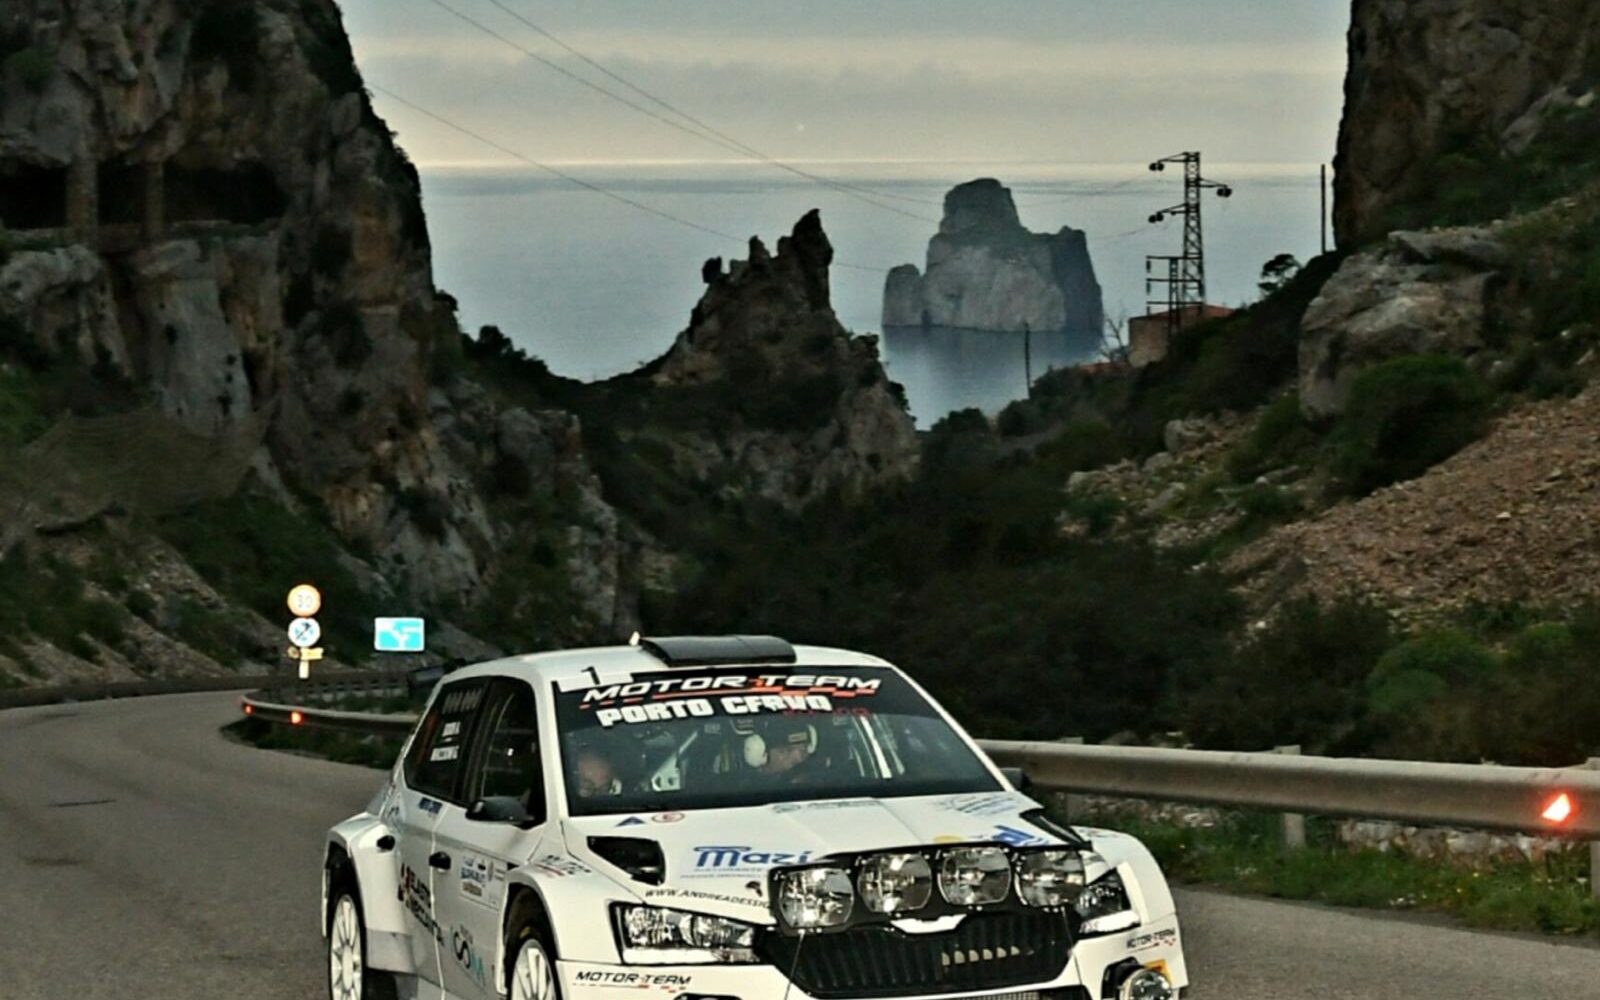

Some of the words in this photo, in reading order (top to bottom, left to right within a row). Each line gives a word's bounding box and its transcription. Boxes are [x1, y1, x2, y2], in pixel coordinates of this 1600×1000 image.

[582, 675, 748, 702] MOTOR
[757, 674, 882, 690] TEAM
[595, 697, 715, 727] PORTO
[575, 971, 640, 982] MOTOR
[645, 974, 692, 985] TEAM
